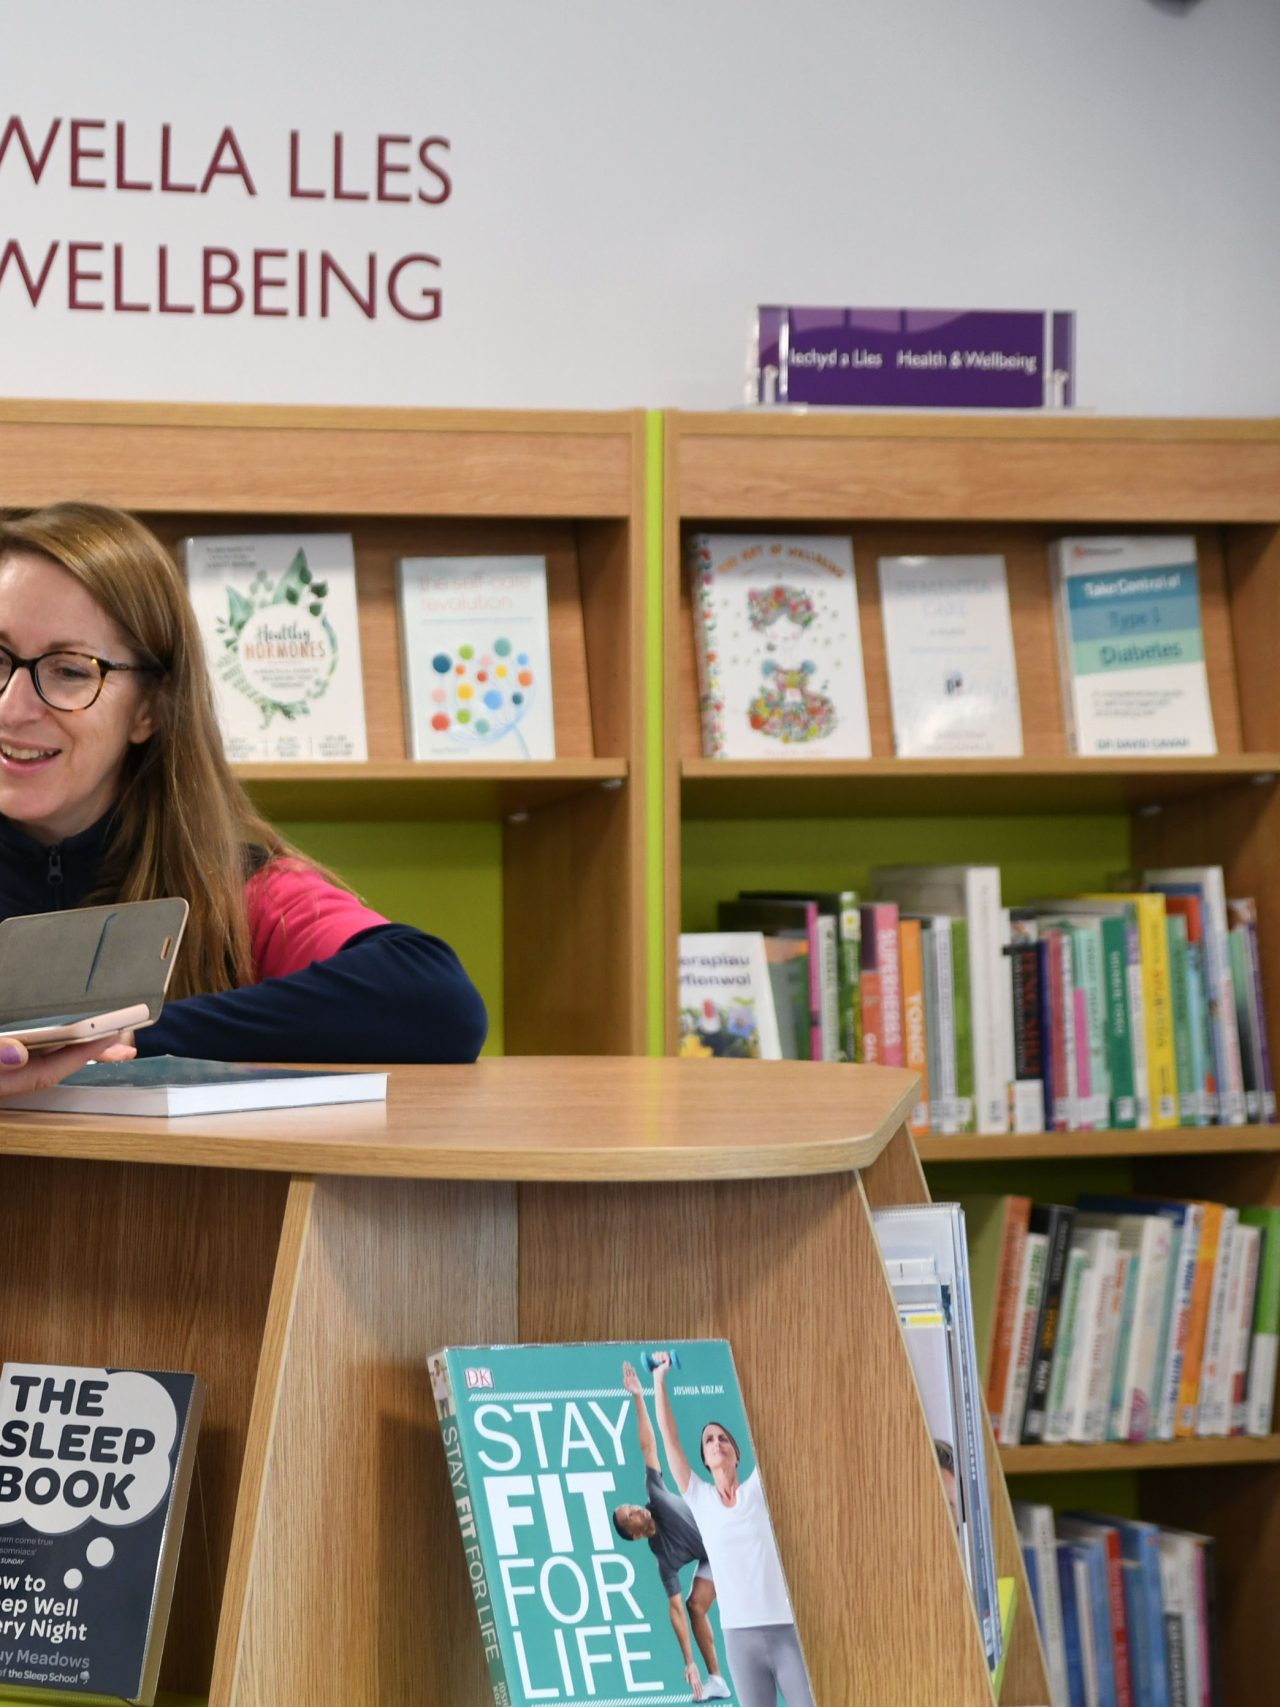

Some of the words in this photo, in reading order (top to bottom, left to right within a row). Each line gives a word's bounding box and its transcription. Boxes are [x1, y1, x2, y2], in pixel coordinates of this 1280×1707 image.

[289, 129, 455, 206] LLES
[897, 350, 946, 368] Health
[950, 351, 962, 367] &
[965, 350, 1037, 375] Wellbeing
[243, 641, 326, 661] HORMONES
[1100, 641, 1183, 666] Diabetes
[679, 953, 751, 968] erapiau
[468, 1369, 492, 1387] DK
[673, 1385, 700, 1396] JOSHUA
[701, 1385, 725, 1396] KOZAK
[10, 1375, 109, 1417] THE
[473, 1400, 631, 1472] STAY
[443, 1425, 467, 1489] STAY
[455, 1494, 477, 1541] FIT
[483, 1471, 616, 1556] FIT
[15, 1537, 36, 1545] come
[37, 1538, 54, 1546] true
[0, 1557, 25, 1566] SUNDAY
[465, 1546, 488, 1602] FOR
[24, 1574, 46, 1592] to
[498, 1553, 645, 1627] FOR
[34, 1596, 79, 1617] Well
[29, 1618, 88, 1644] Night
[477, 1604, 500, 1664] LIFE
[16, 1649, 91, 1668] Meadows
[513, 1623, 665, 1699] LIFE
[8, 1669, 23, 1679] the
[23, 1670, 49, 1683] Sleep
[48, 1672, 79, 1684] School
